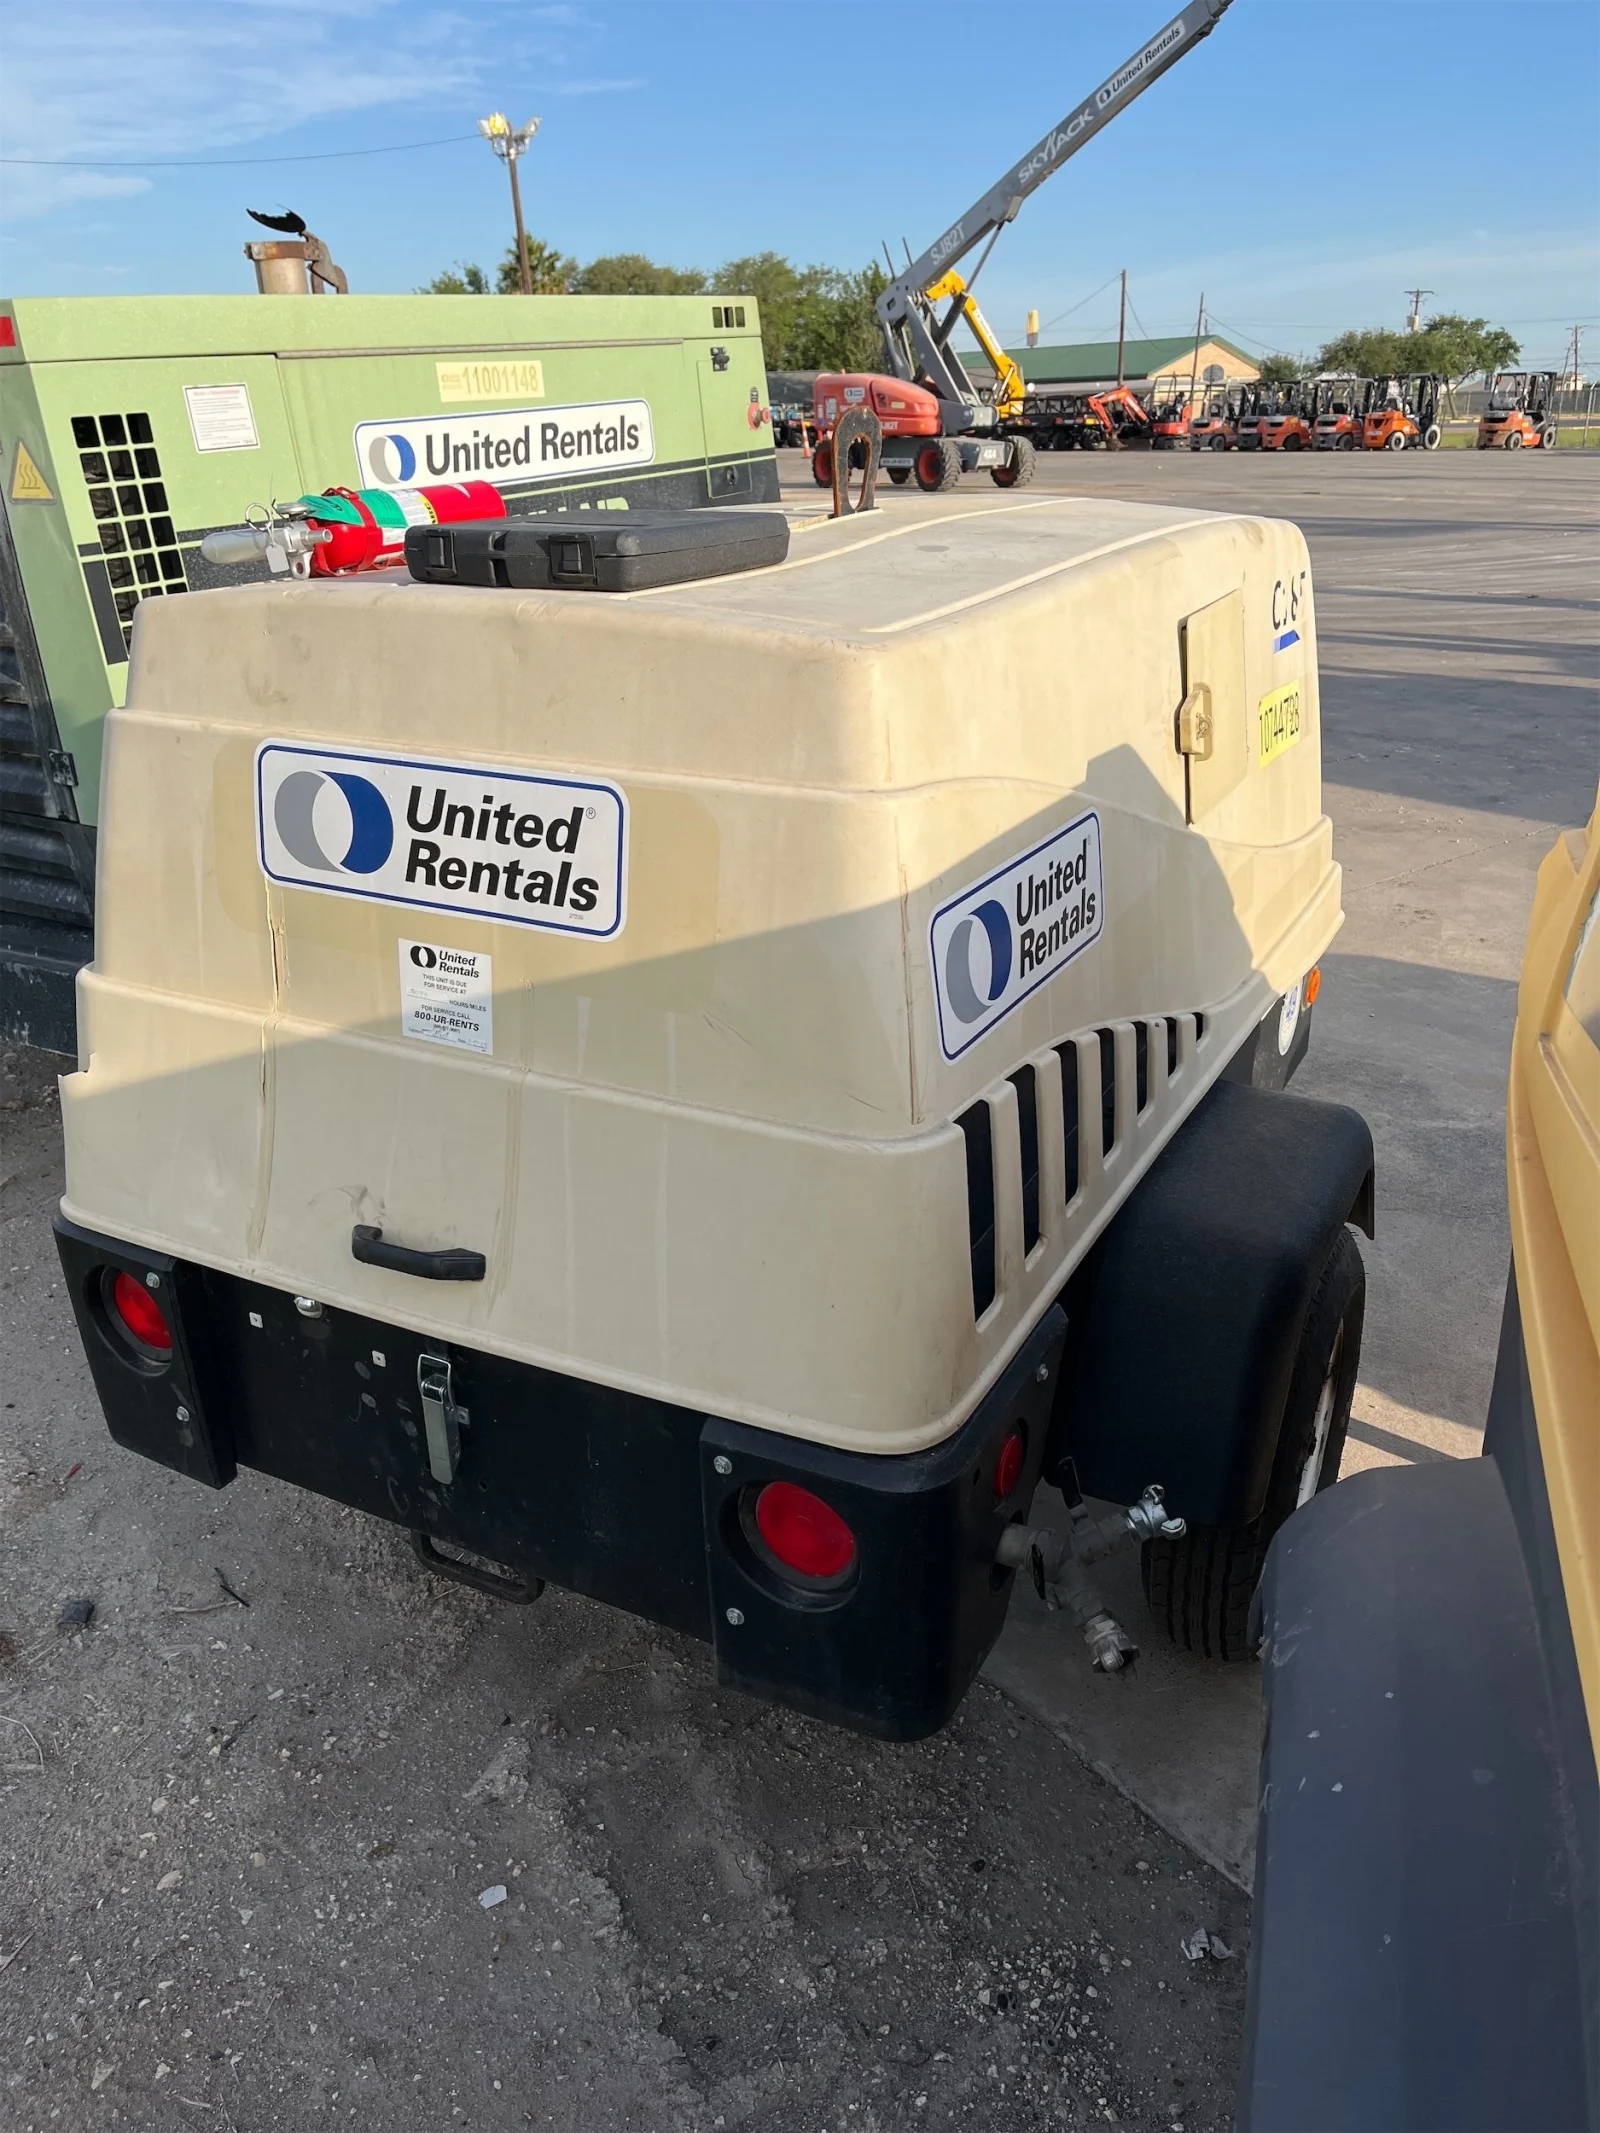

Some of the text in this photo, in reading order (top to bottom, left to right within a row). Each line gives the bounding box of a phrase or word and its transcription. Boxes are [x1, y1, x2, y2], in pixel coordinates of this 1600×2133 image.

[1112, 27, 1180, 92] United Rentals
[1018, 108, 1095, 183] SKYJACK
[930, 221, 965, 266] SJ82T
[463, 364, 538, 395] 11001148
[426, 415, 639, 476] United Rentals
[406, 785, 584, 854] United
[405, 838, 599, 912] Rentals
[1016, 838, 1087, 926] United
[1020, 887, 1096, 979] Rentals
[439, 950, 476, 966] United
[439, 962, 480, 978] Rentals
[436, 976, 448, 984] UNIT
[436, 984, 459, 993] SERVICE
[414, 1011, 480, 1031] 800-UR-RENTS
[433, 1007, 456, 1016] SERVICE
[457, 1012, 471, 1020] CALL
[449, 1000, 486, 1012] HOURS/MILES
